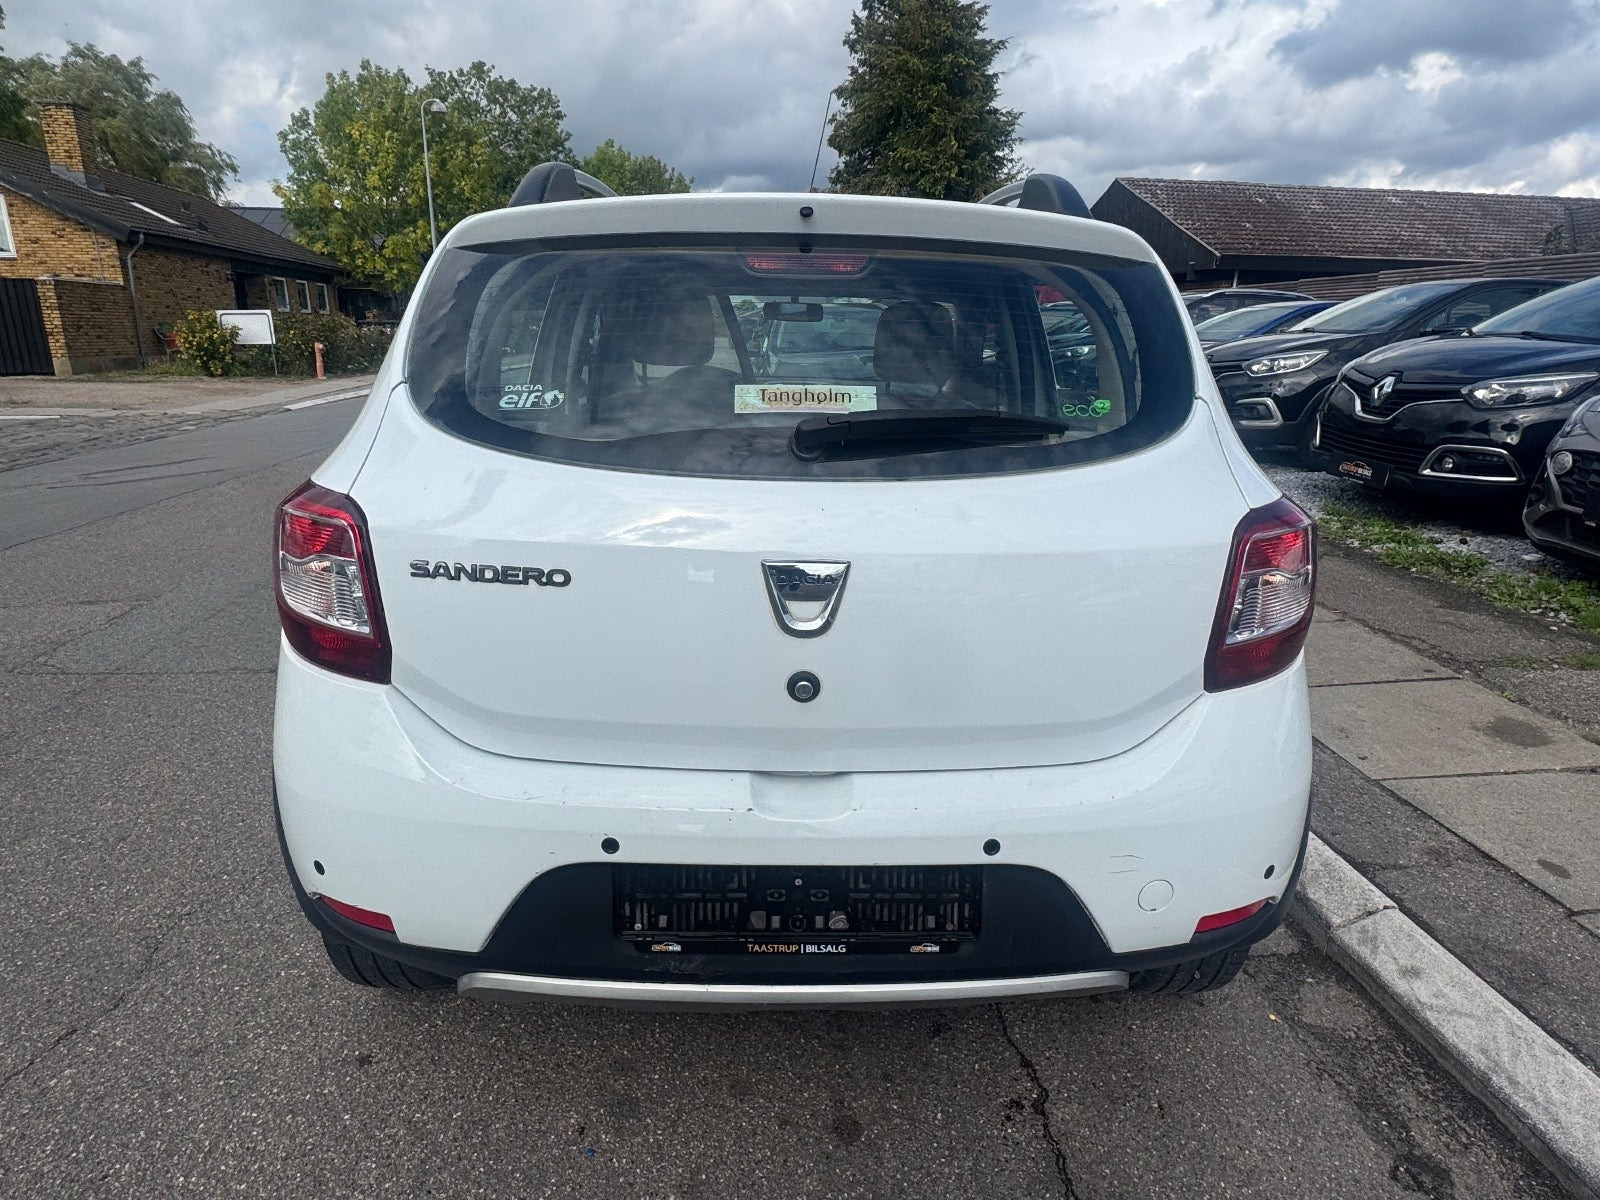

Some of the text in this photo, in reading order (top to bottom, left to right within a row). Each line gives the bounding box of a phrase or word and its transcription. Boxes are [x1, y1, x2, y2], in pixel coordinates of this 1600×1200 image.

[504, 384, 543, 392] DACIA
[499, 392, 542, 408] elf
[759, 388, 852, 405] Tangholm
[409, 560, 572, 587] SANDERO
[747, 944, 847, 953] TAASTRUP BILSALG
